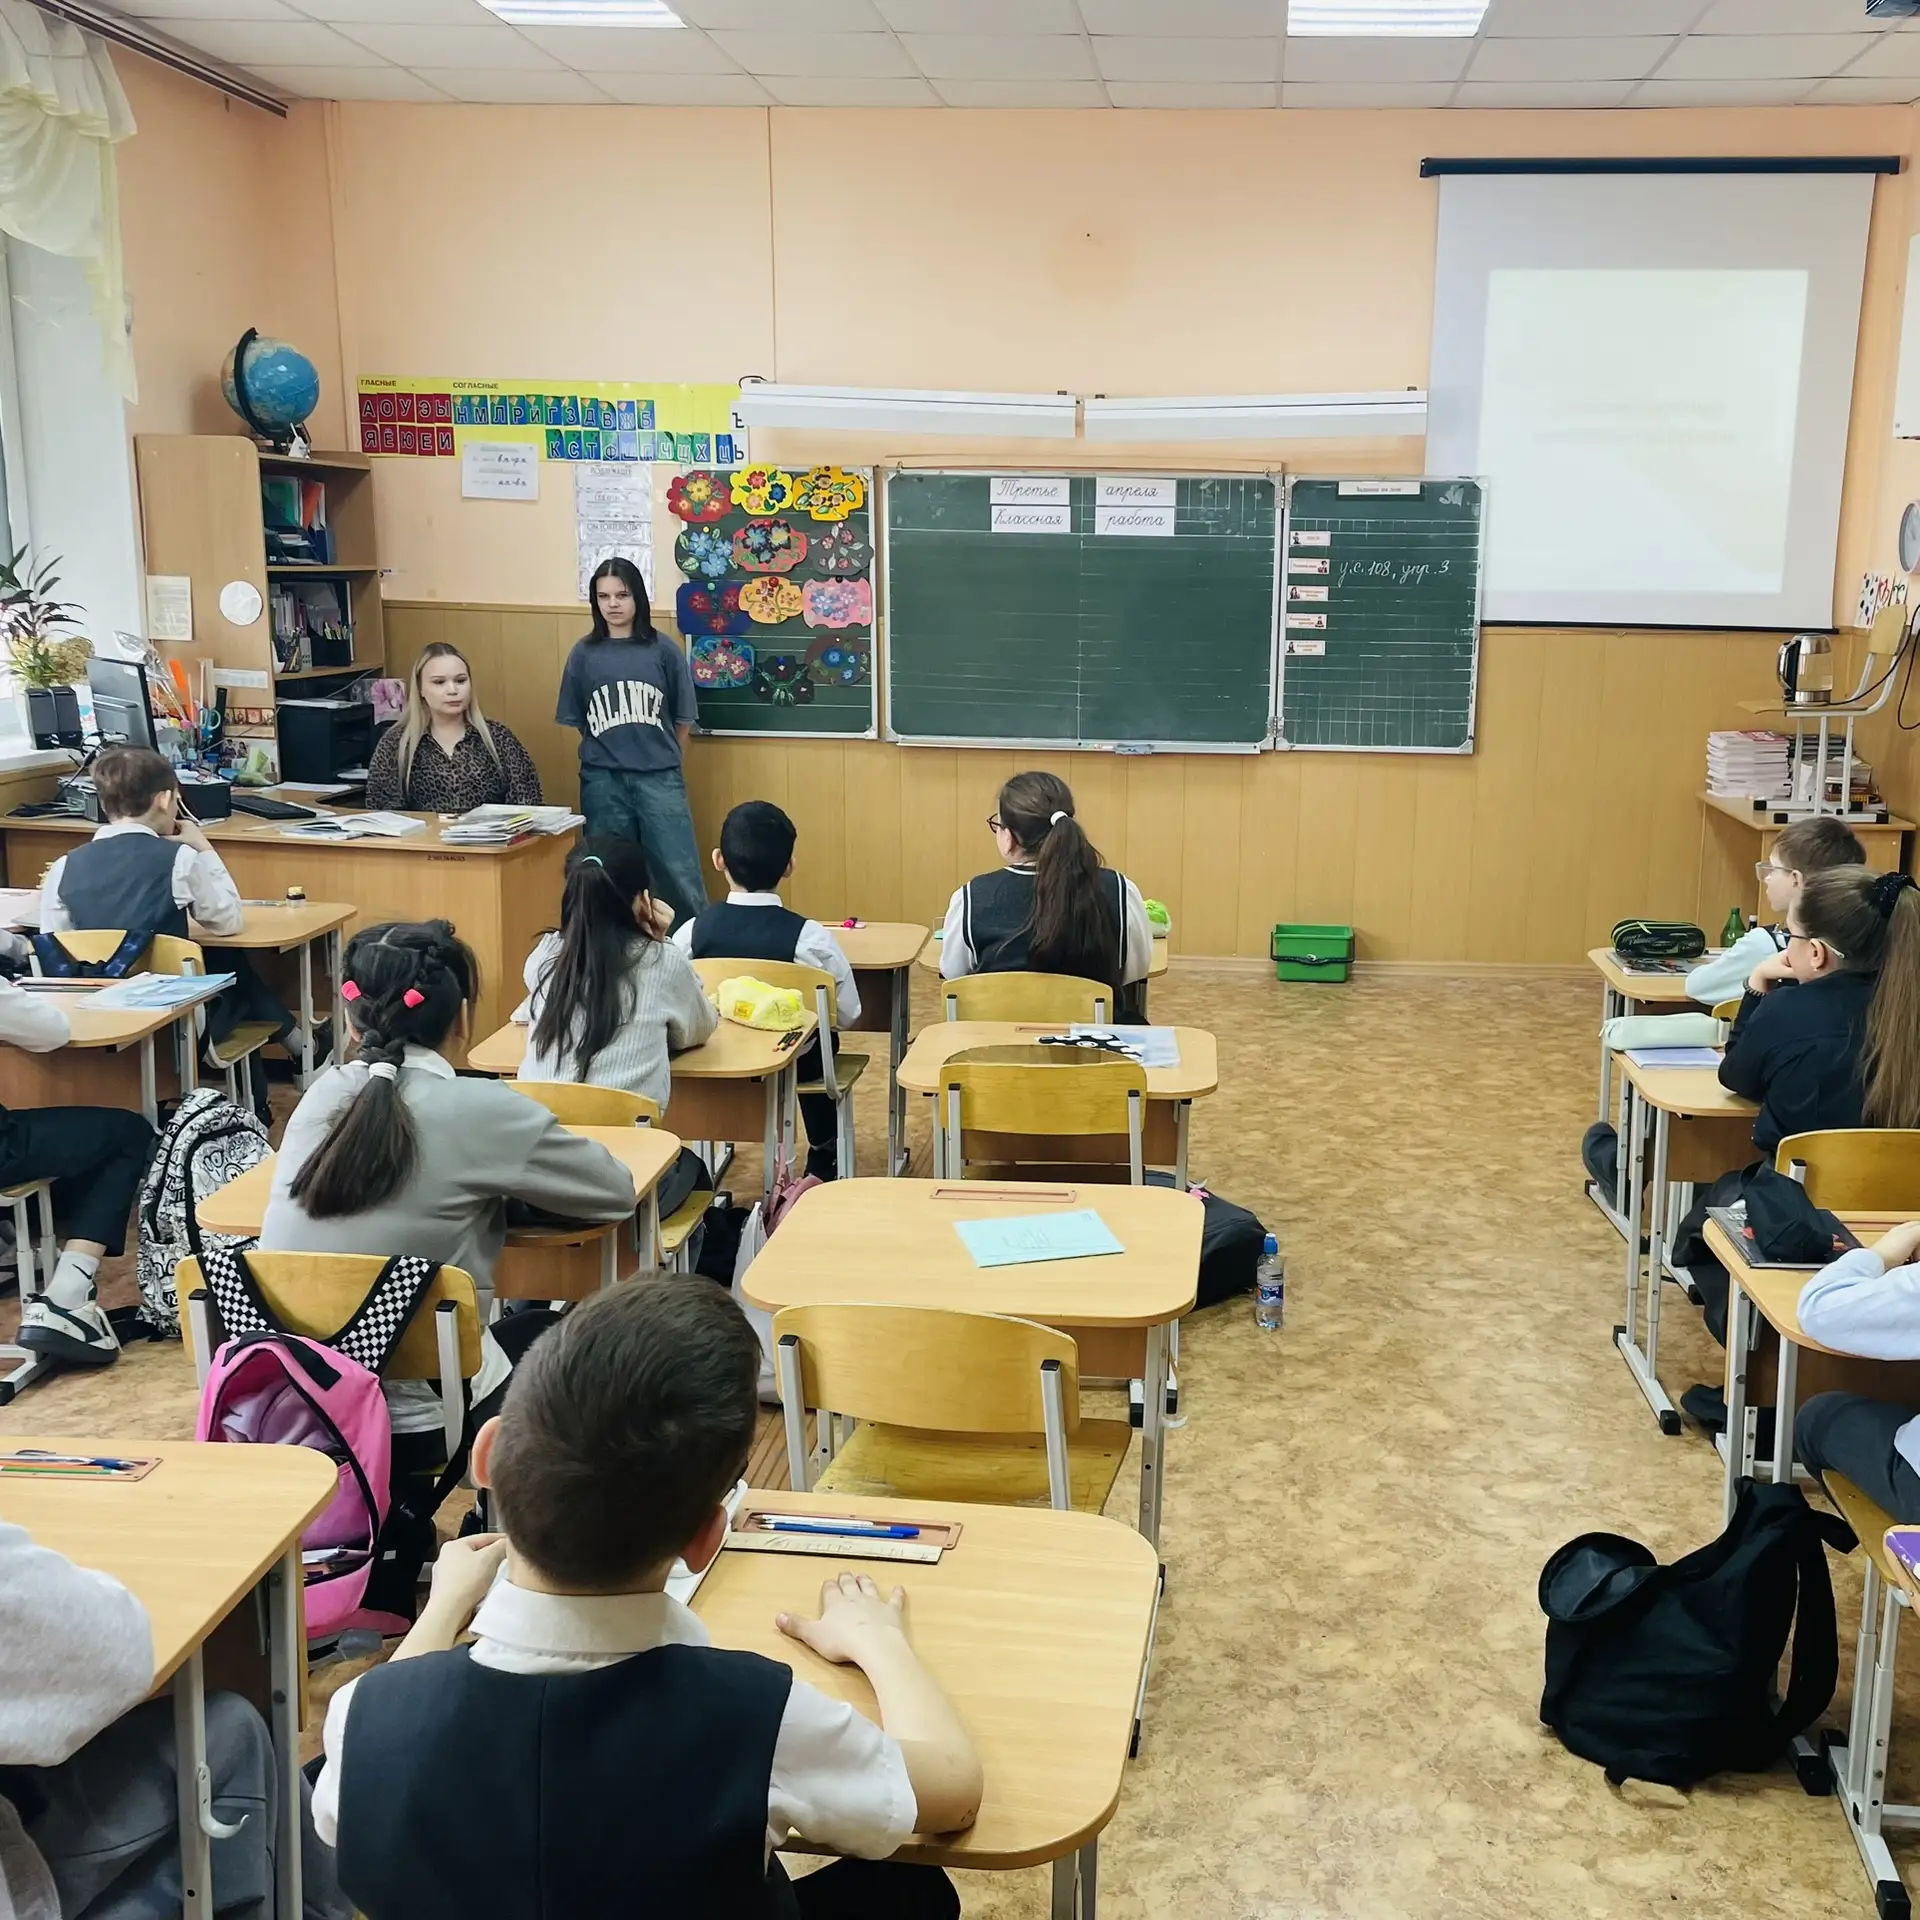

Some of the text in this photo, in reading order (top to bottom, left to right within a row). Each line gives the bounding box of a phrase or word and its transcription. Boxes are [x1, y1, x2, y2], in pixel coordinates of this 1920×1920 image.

[360, 379, 397, 387] ГЛАСНЫЕ
[362, 399, 451, 418] А О У Э Ы
[456, 406, 468, 423] Н
[475, 407, 489, 424] М
[493, 406, 507, 423] Л
[512, 406, 524, 424] Р
[529, 405, 541, 423] Й
[547, 407, 558, 424] Г
[566, 407, 576, 424] З
[583, 408, 595, 426] Д
[602, 412, 613, 428] В
[640, 411, 651, 427] Б
[732, 412, 745, 428] Ъ
[365, 429, 452, 450] Я Ё Ю Е И
[549, 441, 560, 457] К
[567, 441, 579, 458] С
[587, 443, 598, 459] Т
[660, 442, 672, 459] Ч
[677, 443, 691, 463] Щ
[695, 443, 708, 460] Х
[718, 445, 730, 463] Ц
[734, 444, 745, 459] Ь
[997, 479, 1158, 504] Третье апреля
[994, 508, 1166, 531] Классная работа
[586, 680, 664, 739] BALANCE
